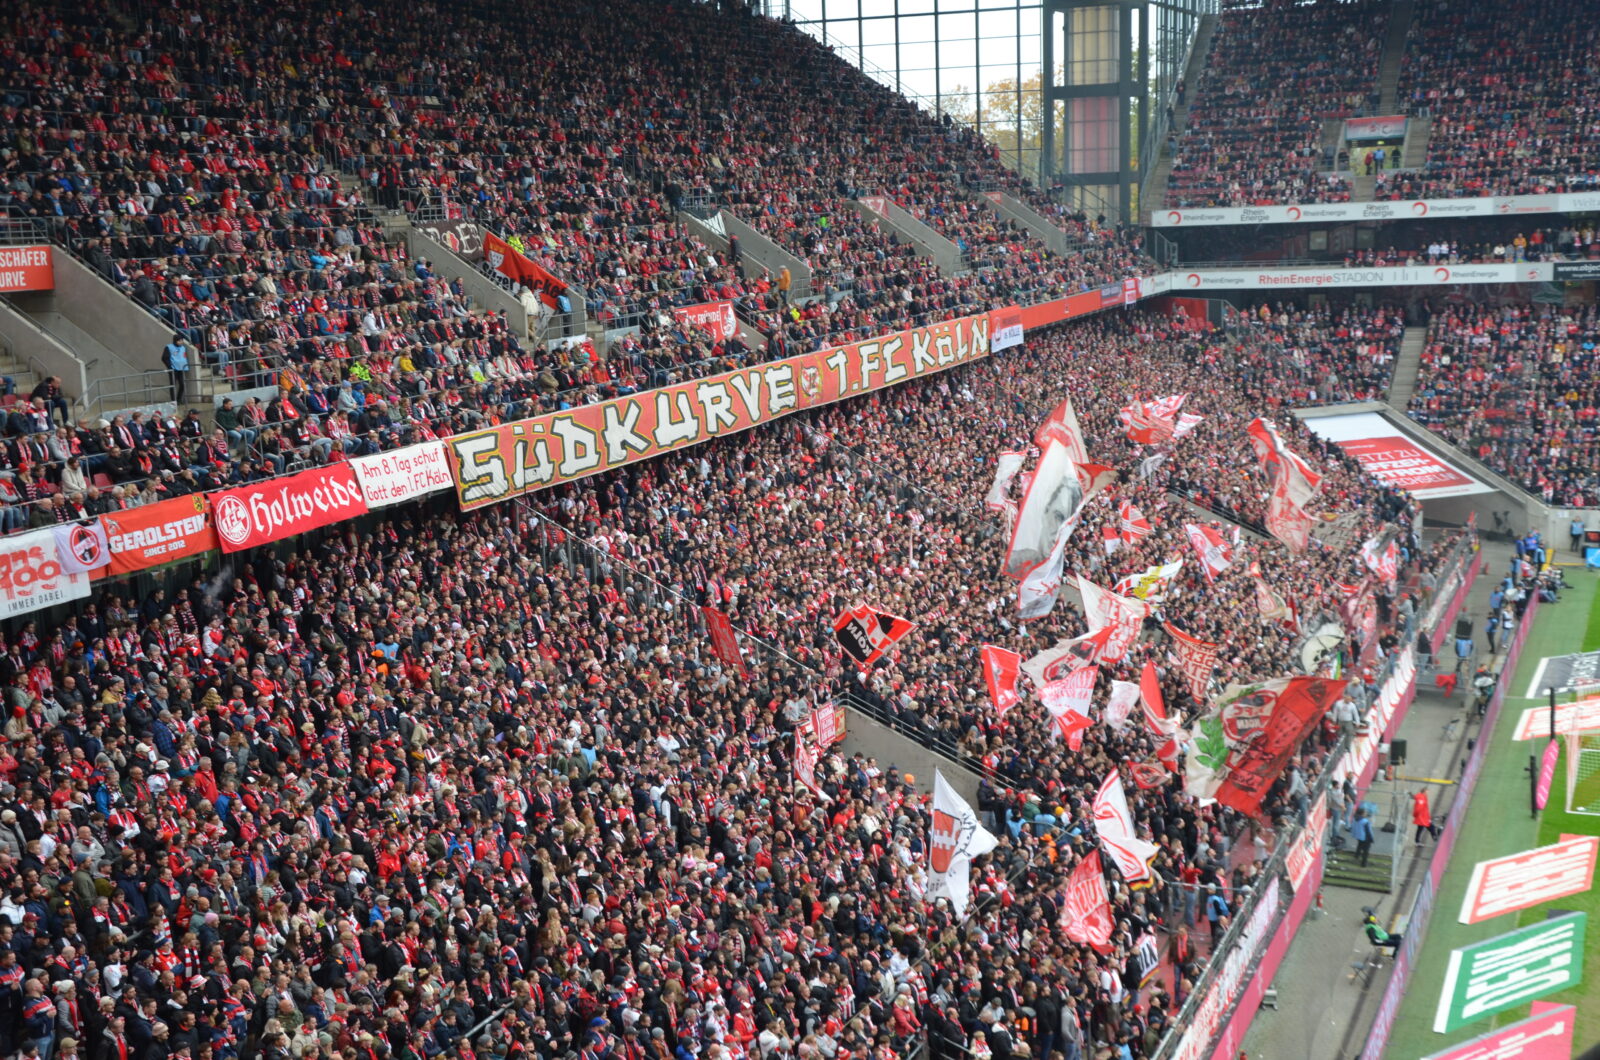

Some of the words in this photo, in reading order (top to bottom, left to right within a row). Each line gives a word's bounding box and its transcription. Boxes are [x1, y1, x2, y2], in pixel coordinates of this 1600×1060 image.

[452, 365, 797, 501] SÜDKURVE
[827, 338, 908, 397] 1.FC
[912, 319, 990, 375] KÖLN
[361, 460, 382, 478] Am
[392, 456, 411, 473] Tag
[413, 447, 439, 467] schuf
[249, 475, 362, 536] Holweide
[365, 484, 388, 501] Gott
[390, 480, 408, 497] den
[110, 513, 207, 554] GEROLSTEIN
[144, 545, 167, 558] SINCE
[168, 539, 187, 552] 2012
[8, 597, 36, 612] IMMER
[38, 589, 64, 604] DABEI
[1462, 922, 1576, 1019] DEVK
